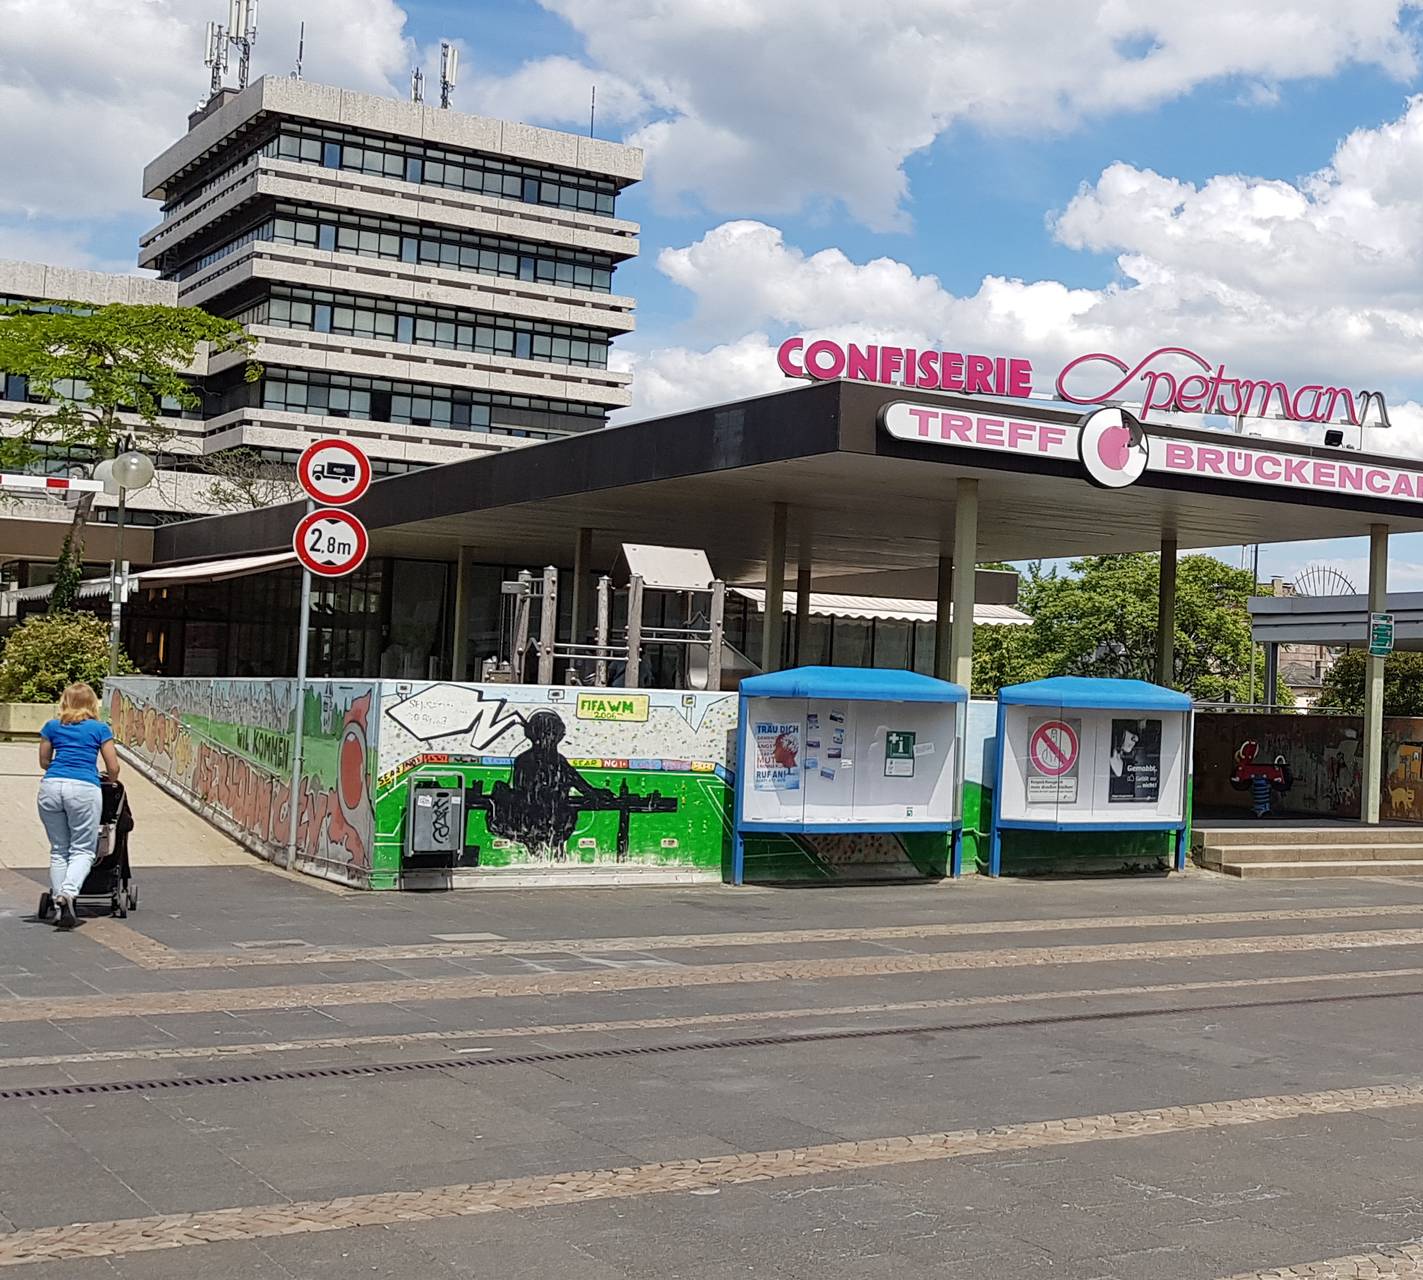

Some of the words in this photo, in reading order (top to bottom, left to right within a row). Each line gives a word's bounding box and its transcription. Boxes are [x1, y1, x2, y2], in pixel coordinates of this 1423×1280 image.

[777, 337, 1034, 398] CONFISERIE
[1056, 346, 1392, 428] Spetsmann
[909, 408, 1067, 452] TREFF
[581, 700, 606, 712] FIFA
[607, 700, 634, 714] WM
[757, 725, 778, 733] TRAU
[779, 725, 799, 734] DICH
